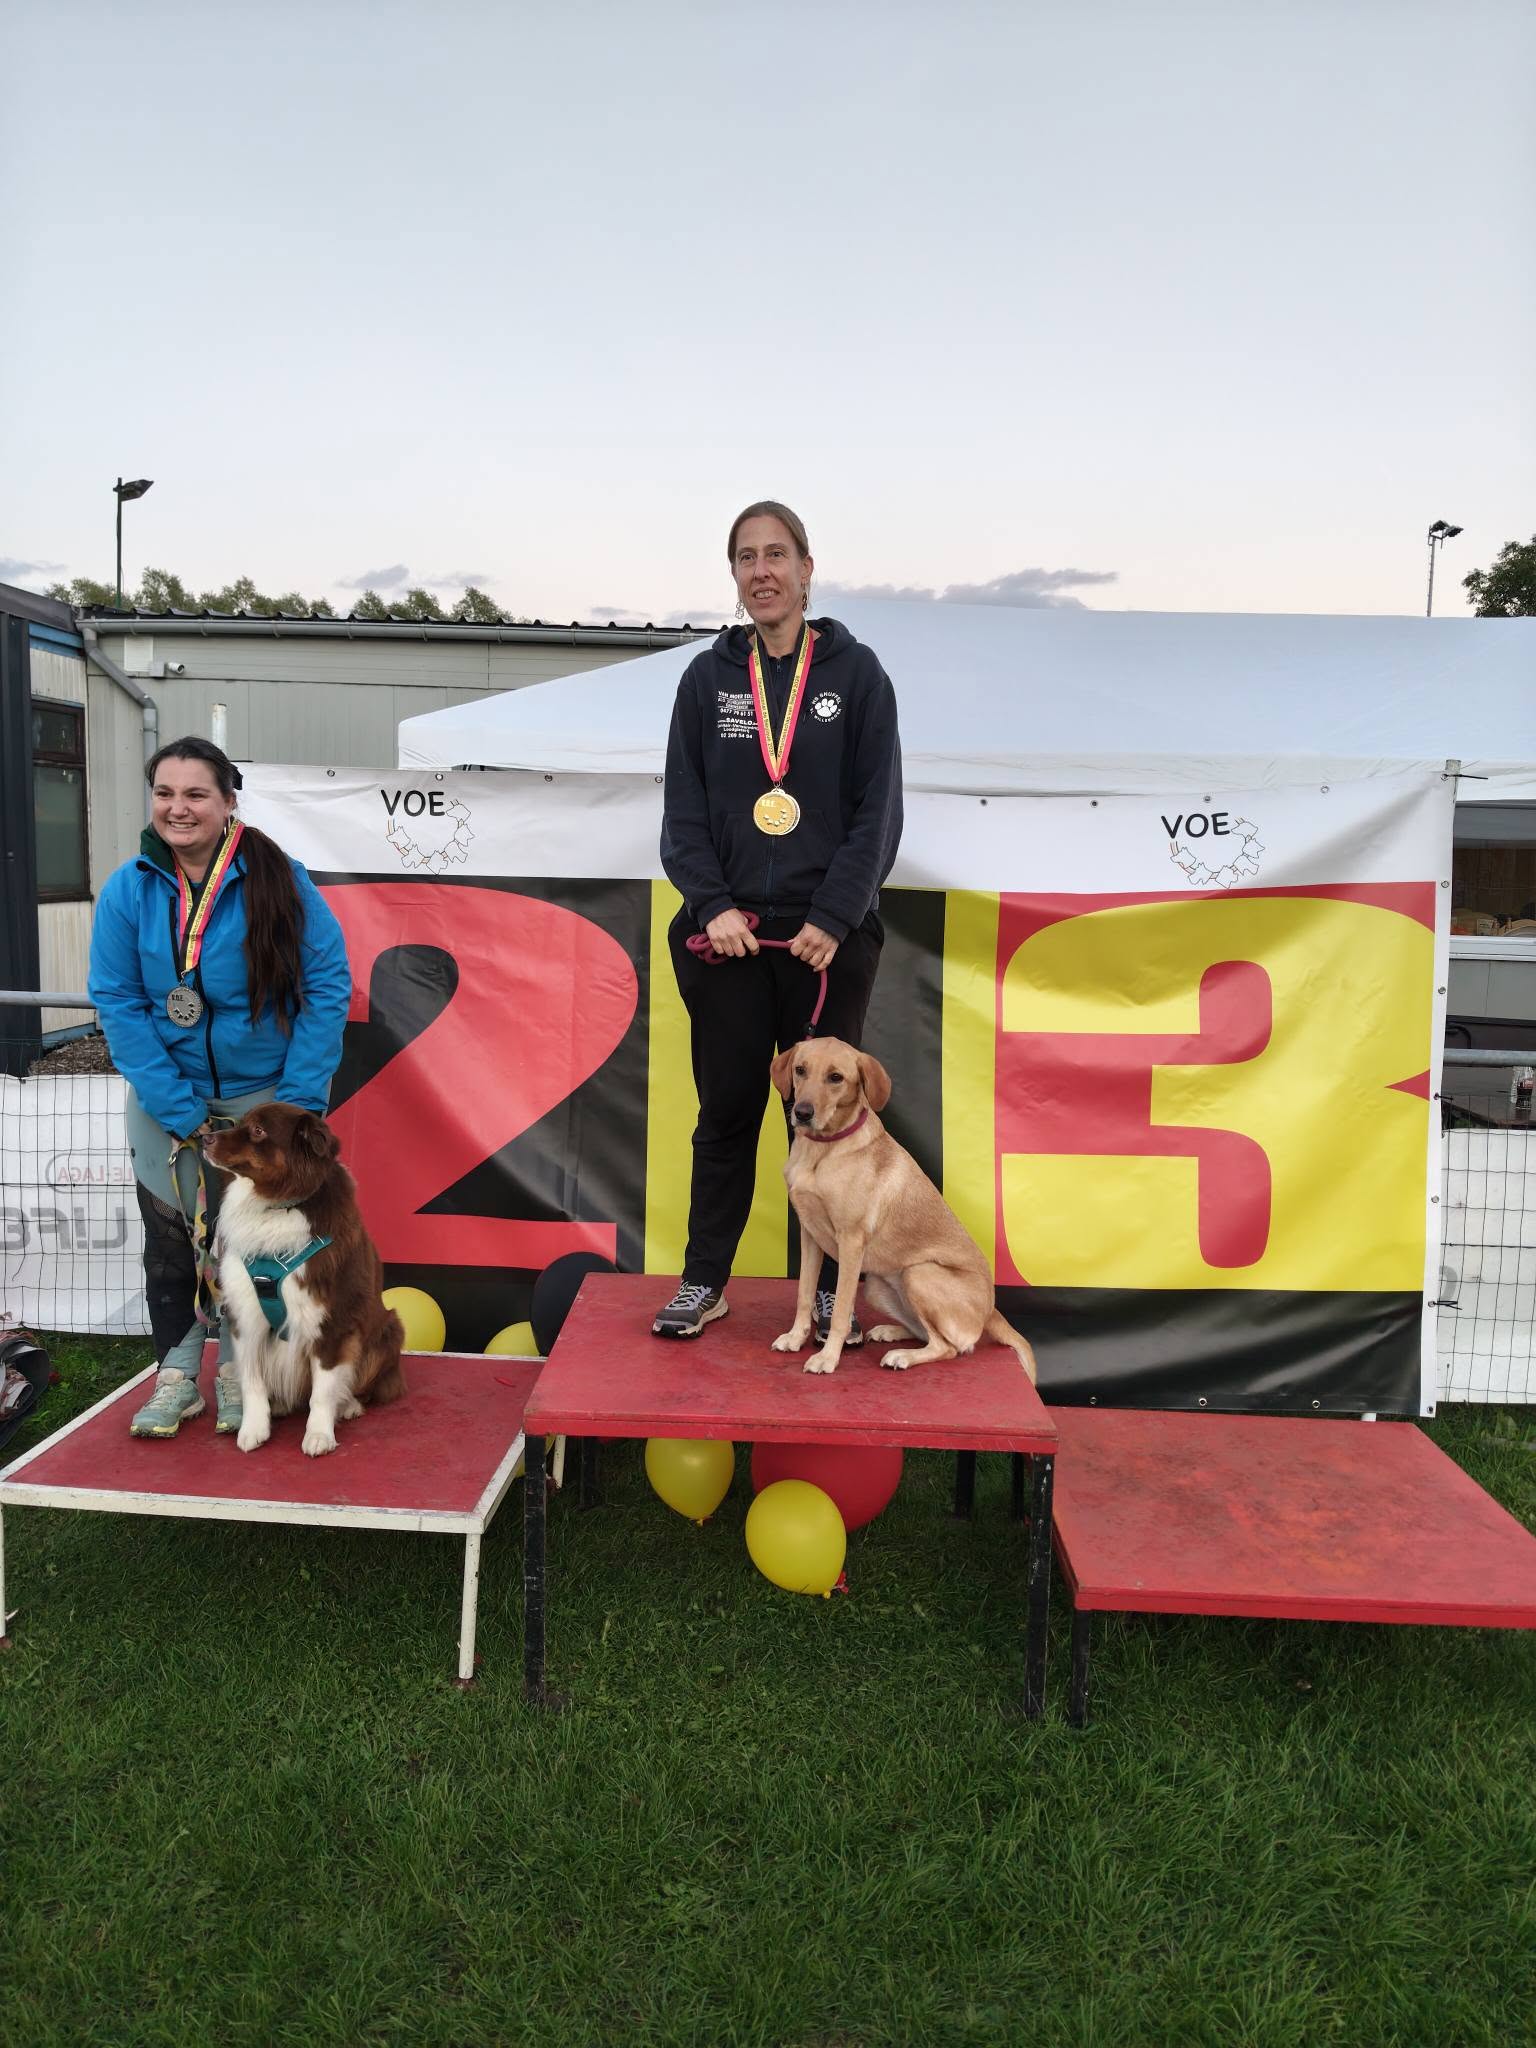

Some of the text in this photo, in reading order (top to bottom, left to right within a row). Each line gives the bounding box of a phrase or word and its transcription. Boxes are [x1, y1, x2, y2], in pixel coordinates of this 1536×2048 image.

[381, 789, 445, 817] VOE
[1161, 812, 1230, 838] VOE
[317, 883, 638, 1270] 2
[1003, 897, 1434, 1290] 3
